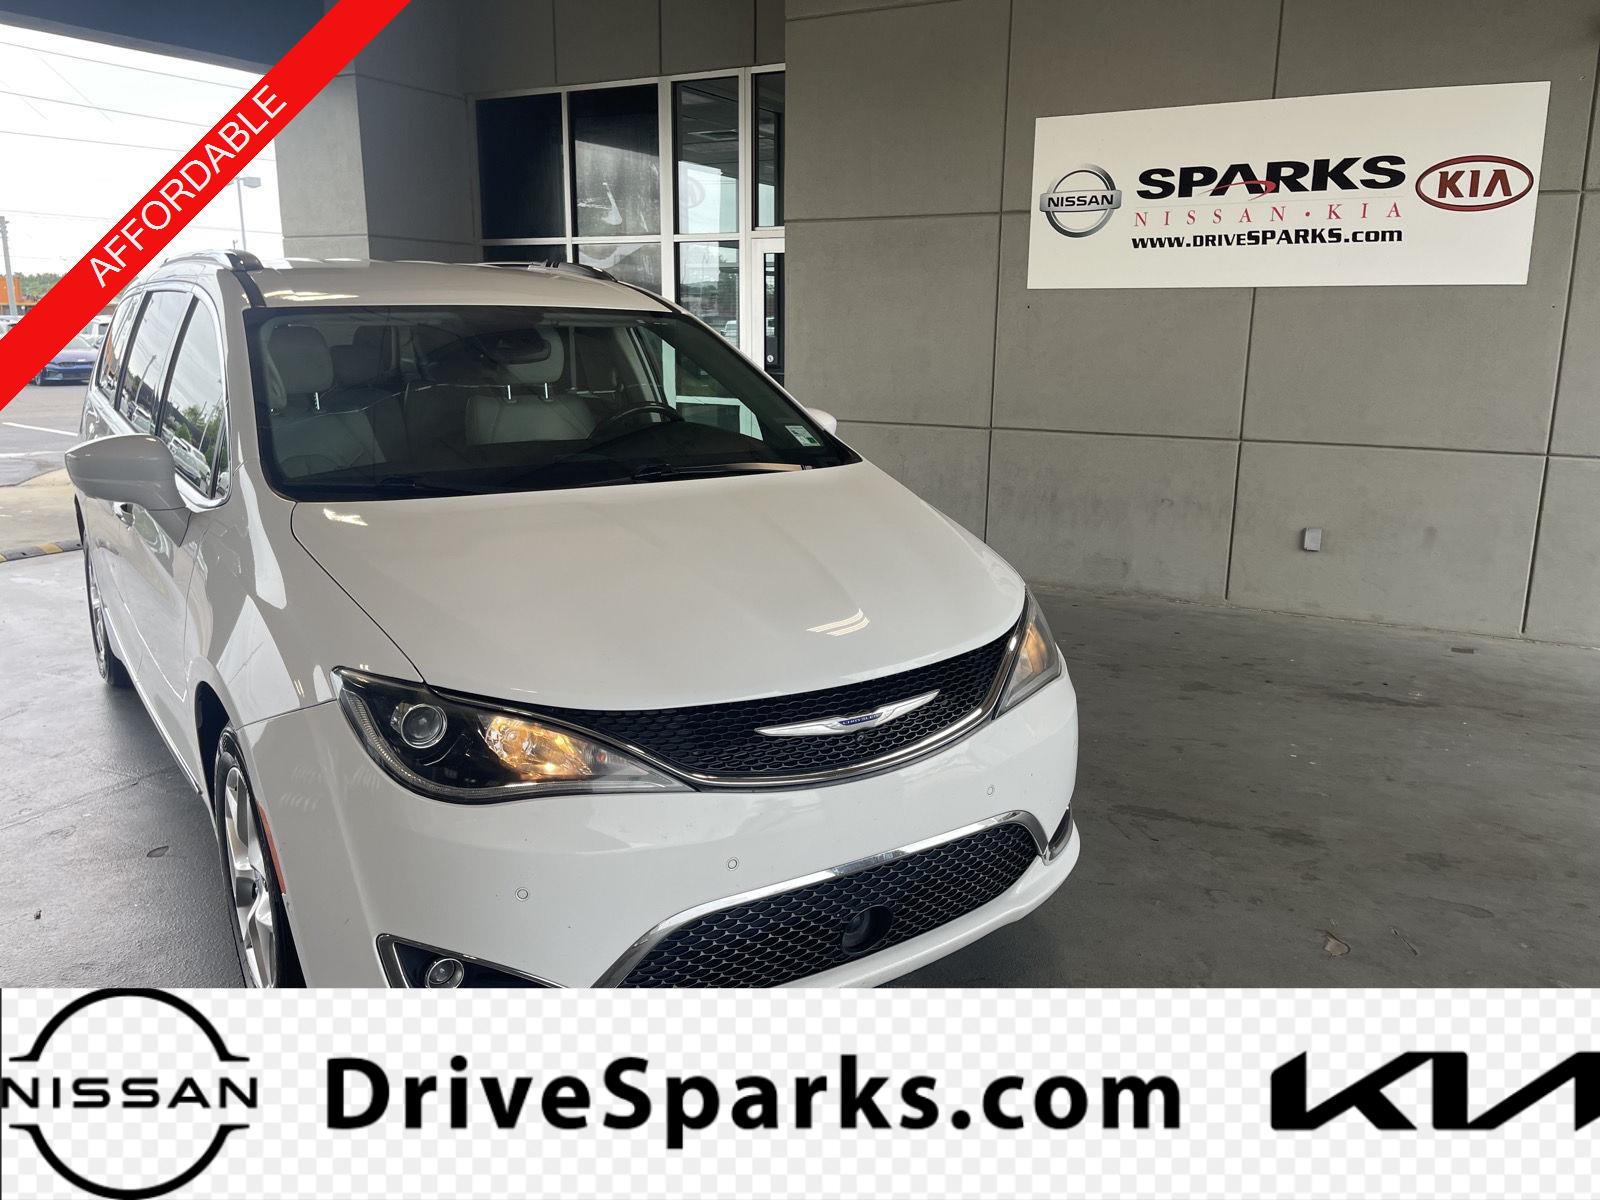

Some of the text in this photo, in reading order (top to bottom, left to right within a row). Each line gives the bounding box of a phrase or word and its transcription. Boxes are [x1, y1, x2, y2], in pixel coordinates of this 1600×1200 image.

[1136, 155, 1406, 200] SPARKS
[1437, 169, 1515, 199] KIA
[1046, 193, 1115, 209] NISSAN
